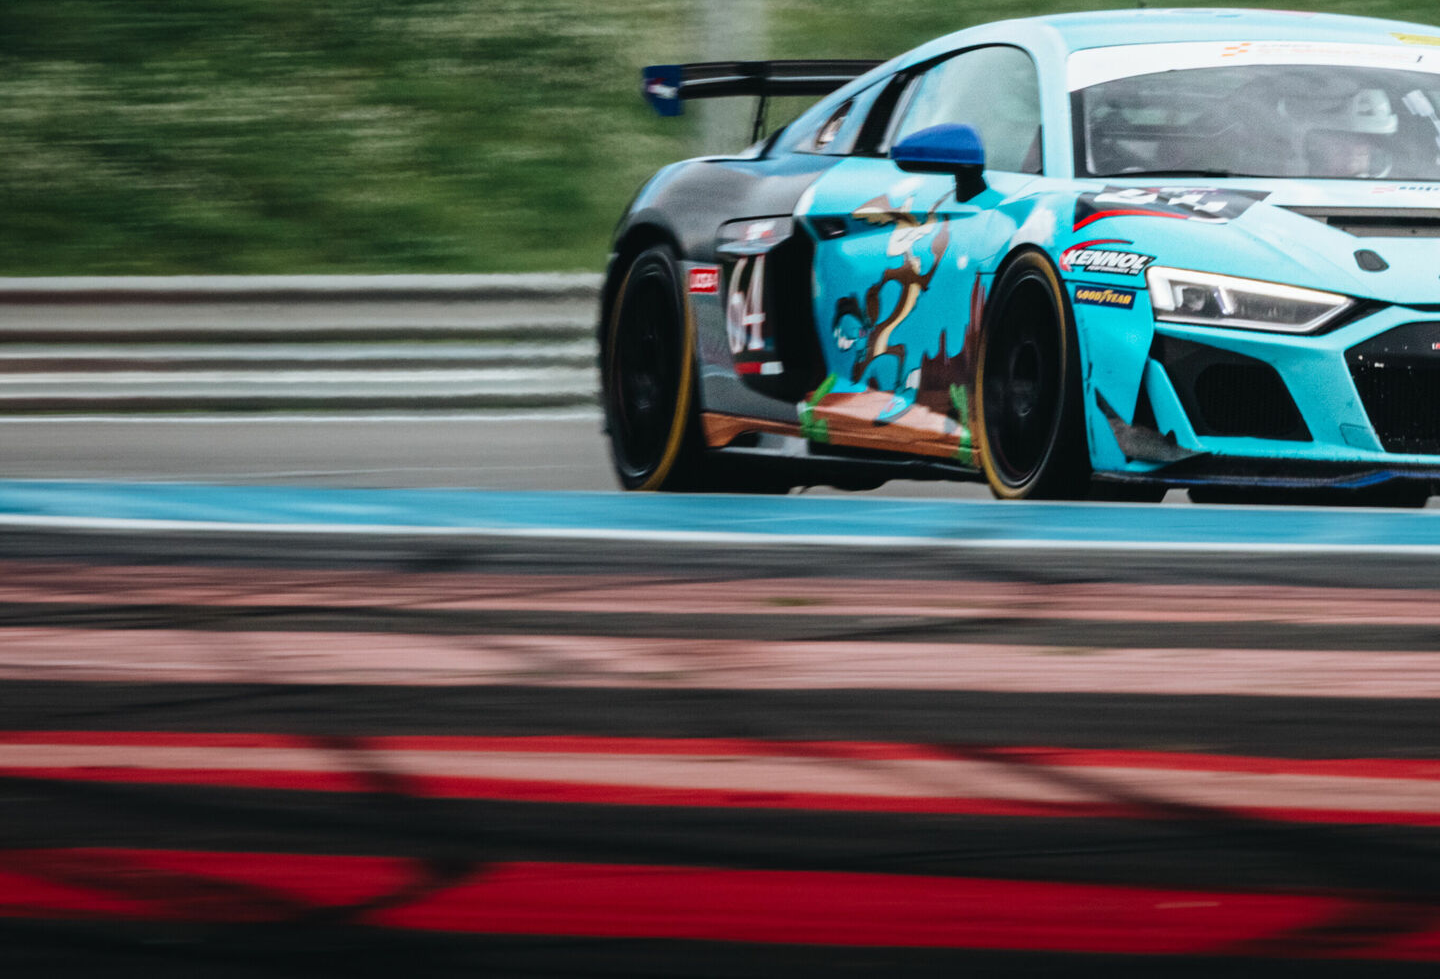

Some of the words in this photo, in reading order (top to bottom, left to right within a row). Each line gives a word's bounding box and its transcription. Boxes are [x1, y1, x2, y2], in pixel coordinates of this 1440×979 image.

[1063, 249, 1149, 271] KENNOL
[726, 254, 766, 355] 64
[1076, 289, 1132, 305] GOODYEAR
